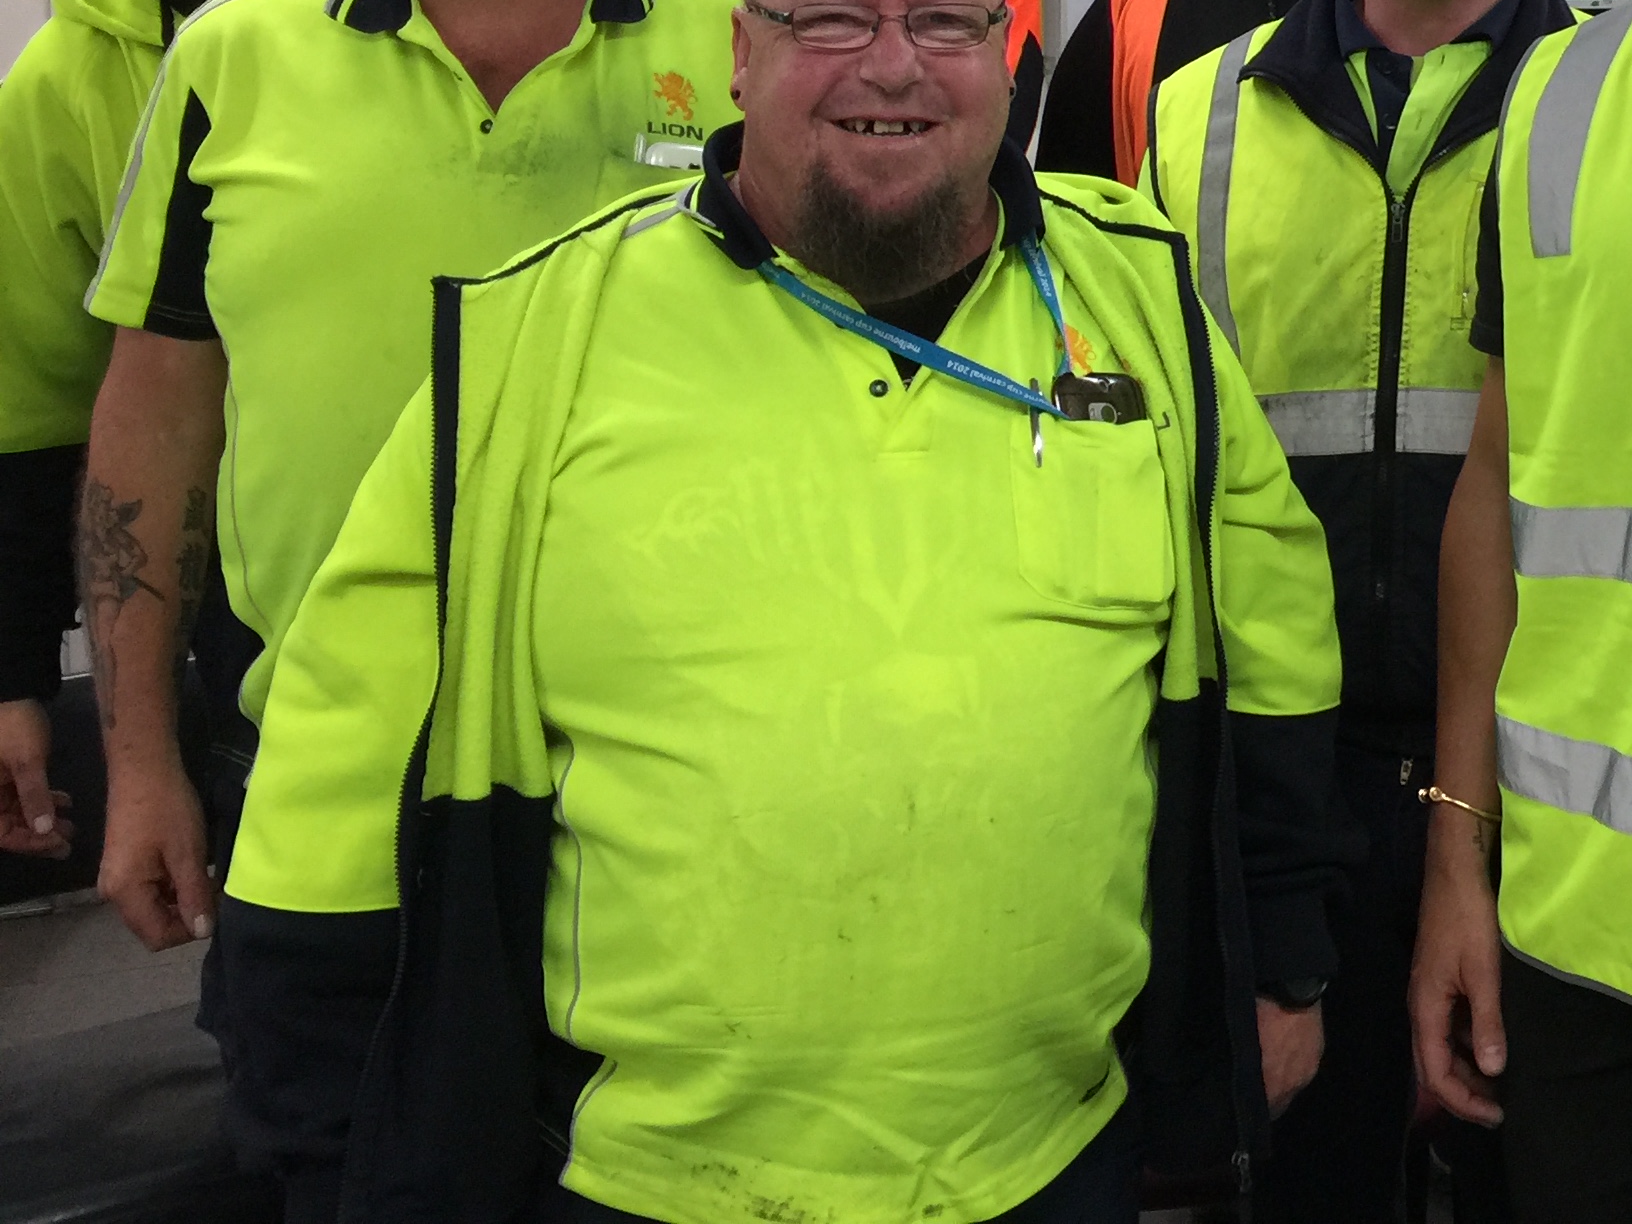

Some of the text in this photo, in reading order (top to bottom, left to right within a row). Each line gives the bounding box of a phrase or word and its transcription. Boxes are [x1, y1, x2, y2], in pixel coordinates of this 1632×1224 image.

[647, 121, 703, 141] LION
[800, 292, 921, 354] melbourne cup carnival 2014
[946, 359, 968, 375] 2014
[969, 369, 1007, 387] carnival
[1006, 384, 1023, 395] cup
